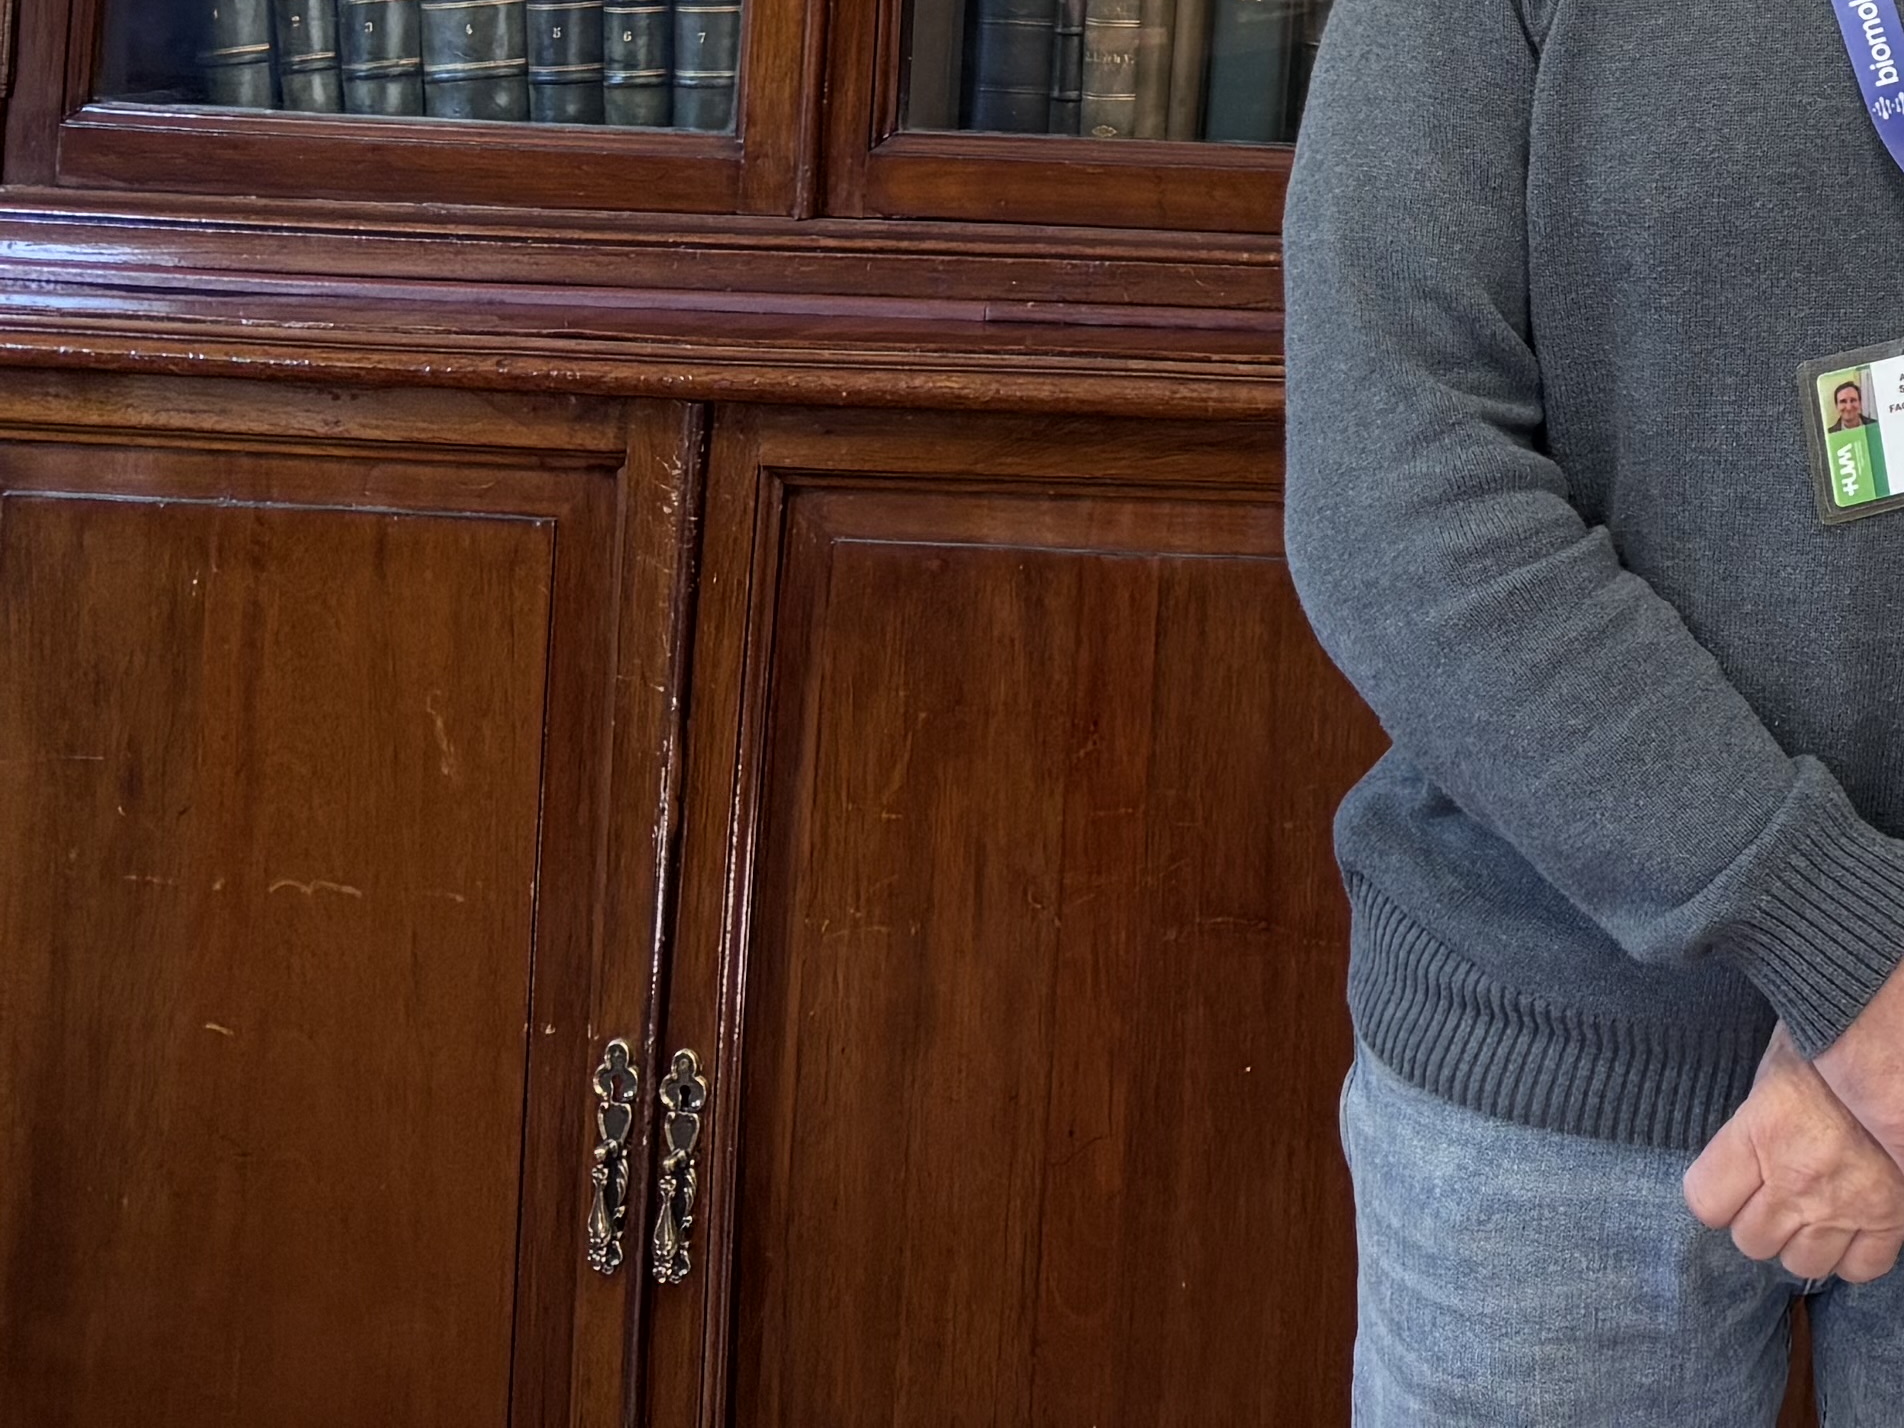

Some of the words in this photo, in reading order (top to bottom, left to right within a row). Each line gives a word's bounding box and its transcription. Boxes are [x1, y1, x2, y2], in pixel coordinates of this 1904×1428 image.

[553, 27, 561, 39] 5
[623, 31, 632, 42] 6
[697, 32, 706, 43] 7
